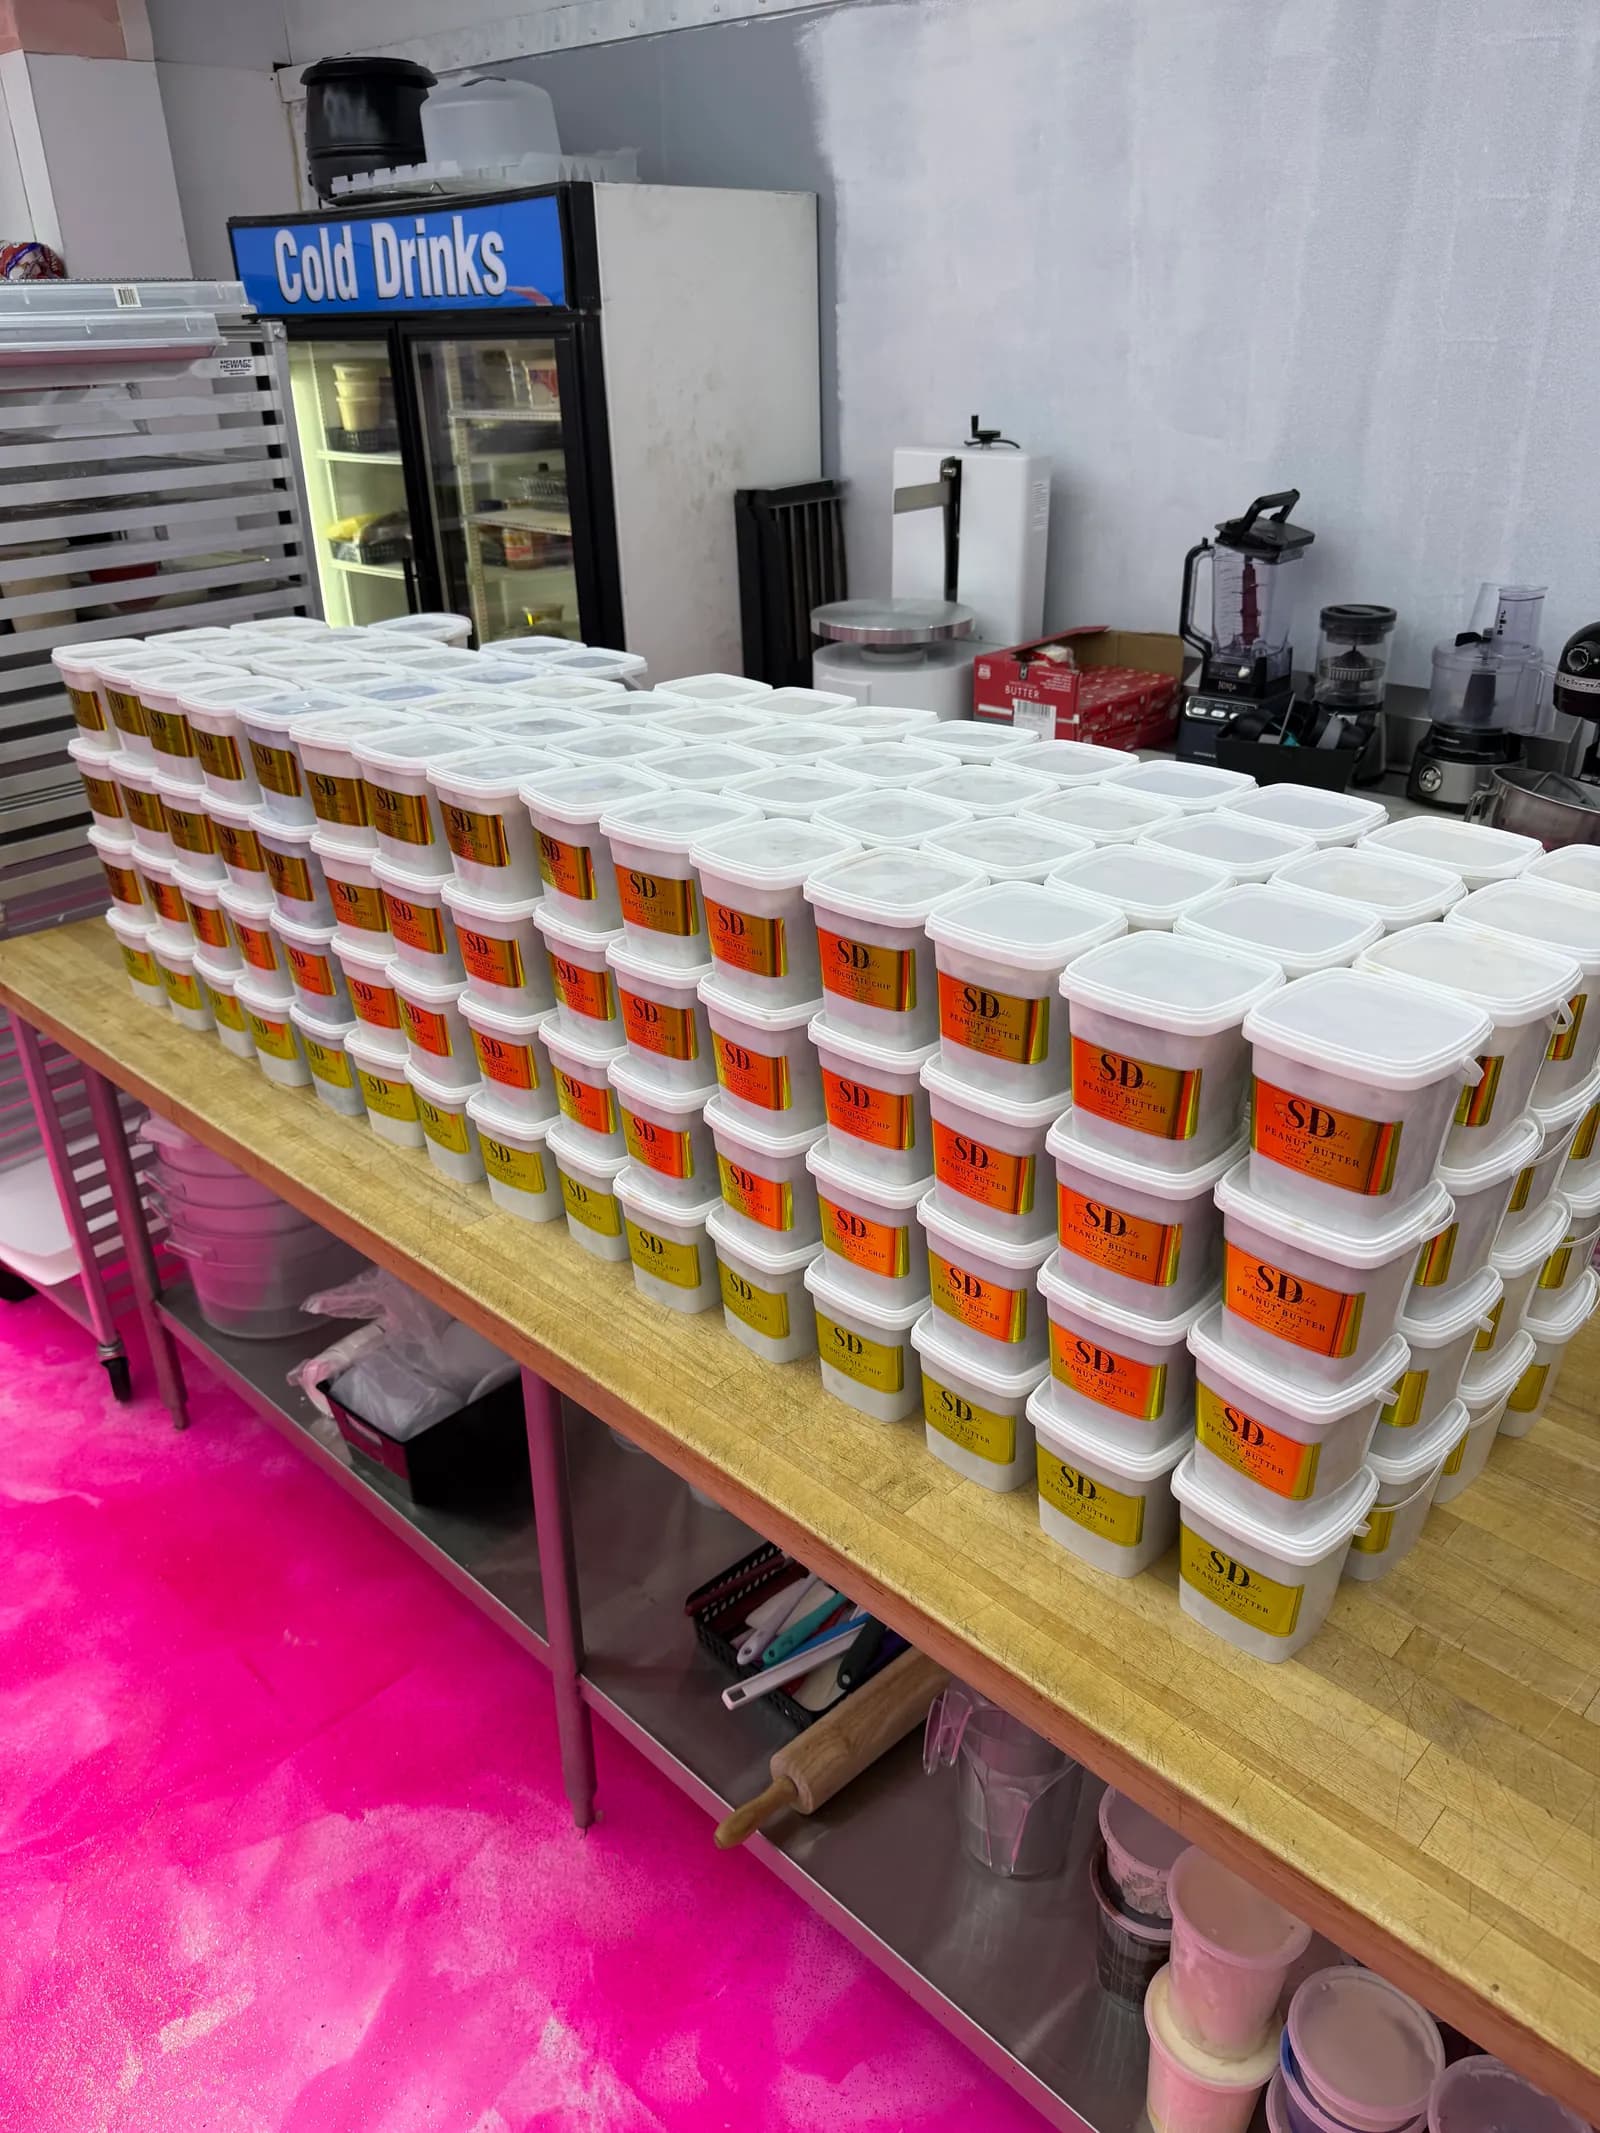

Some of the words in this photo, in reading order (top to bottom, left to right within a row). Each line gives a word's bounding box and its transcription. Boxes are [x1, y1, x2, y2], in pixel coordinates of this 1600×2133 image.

[274, 225, 359, 303] Cold
[371, 216, 508, 298] Drinks
[1005, 685, 1040, 698] BUTTER
[315, 776, 336, 796] SD
[450, 809, 471, 832] SD
[541, 837, 559, 861] SD
[337, 883, 358, 903] SD
[630, 873, 656, 898] SD
[718, 908, 744, 936] SD
[466, 932, 488, 954] SD
[837, 939, 869, 969] SD
[557, 960, 578, 984] SD
[353, 982, 372, 1001] SD
[871, 981, 891, 991] CHIP
[632, 998, 657, 1023] SD
[962, 987, 999, 1018] SD
[481, 1035, 504, 1058] SD
[725, 1043, 749, 1070] SD
[1100, 1053, 1143, 1089] SD
[367, 1076, 388, 1095] SD
[562, 1075, 581, 1098] SD
[839, 1080, 869, 1108] SD
[1083, 1079, 1119, 1101] PEANUT
[1125, 1096, 1167, 1114] BUTTER
[633, 1118, 655, 1142] SD
[872, 1120, 890, 1130] CHIP
[1286, 1099, 1336, 1138] SD
[490, 1140, 510, 1162] SD
[954, 1136, 988, 1169] SD
[1264, 1124, 1309, 1148] PEANUT
[1313, 1145, 1361, 1169] BUTTER
[568, 1180, 587, 1202] SD
[730, 1165, 754, 1192] SD
[837, 1209, 866, 1238] SD
[1084, 1202, 1126, 1237] SD
[639, 1231, 663, 1254] SD
[868, 1248, 886, 1259] CHIP
[1068, 1223, 1105, 1249] PEANUT
[1108, 1242, 1148, 1262] BUTTER
[730, 1273, 752, 1300] SD
[949, 1267, 981, 1298] SD
[1255, 1265, 1303, 1303] SD
[1236, 1285, 1278, 1311] PEANUT
[1282, 1308, 1327, 1332] BUTTER
[834, 1327, 862, 1354] SD
[1075, 1340, 1115, 1374] SD
[864, 1366, 881, 1376] CHIP
[1060, 1358, 1095, 1380] PEANUT
[1099, 1377, 1136, 1399] BUTTER
[941, 1390, 972, 1421] SD
[1222, 1407, 1264, 1446] SD
[1206, 1422, 1243, 1451] PEANUT
[1245, 1449, 1284, 1476] BUTTER
[1061, 1465, 1096, 1499] SD
[1046, 1478, 1079, 1505] PEANUT
[1081, 1502, 1115, 1525] BUTTER
[1208, 1550, 1250, 1587] SD
[1191, 1561, 1230, 1591] PEANUT
[1231, 1588, 1269, 1615] BUTTER
